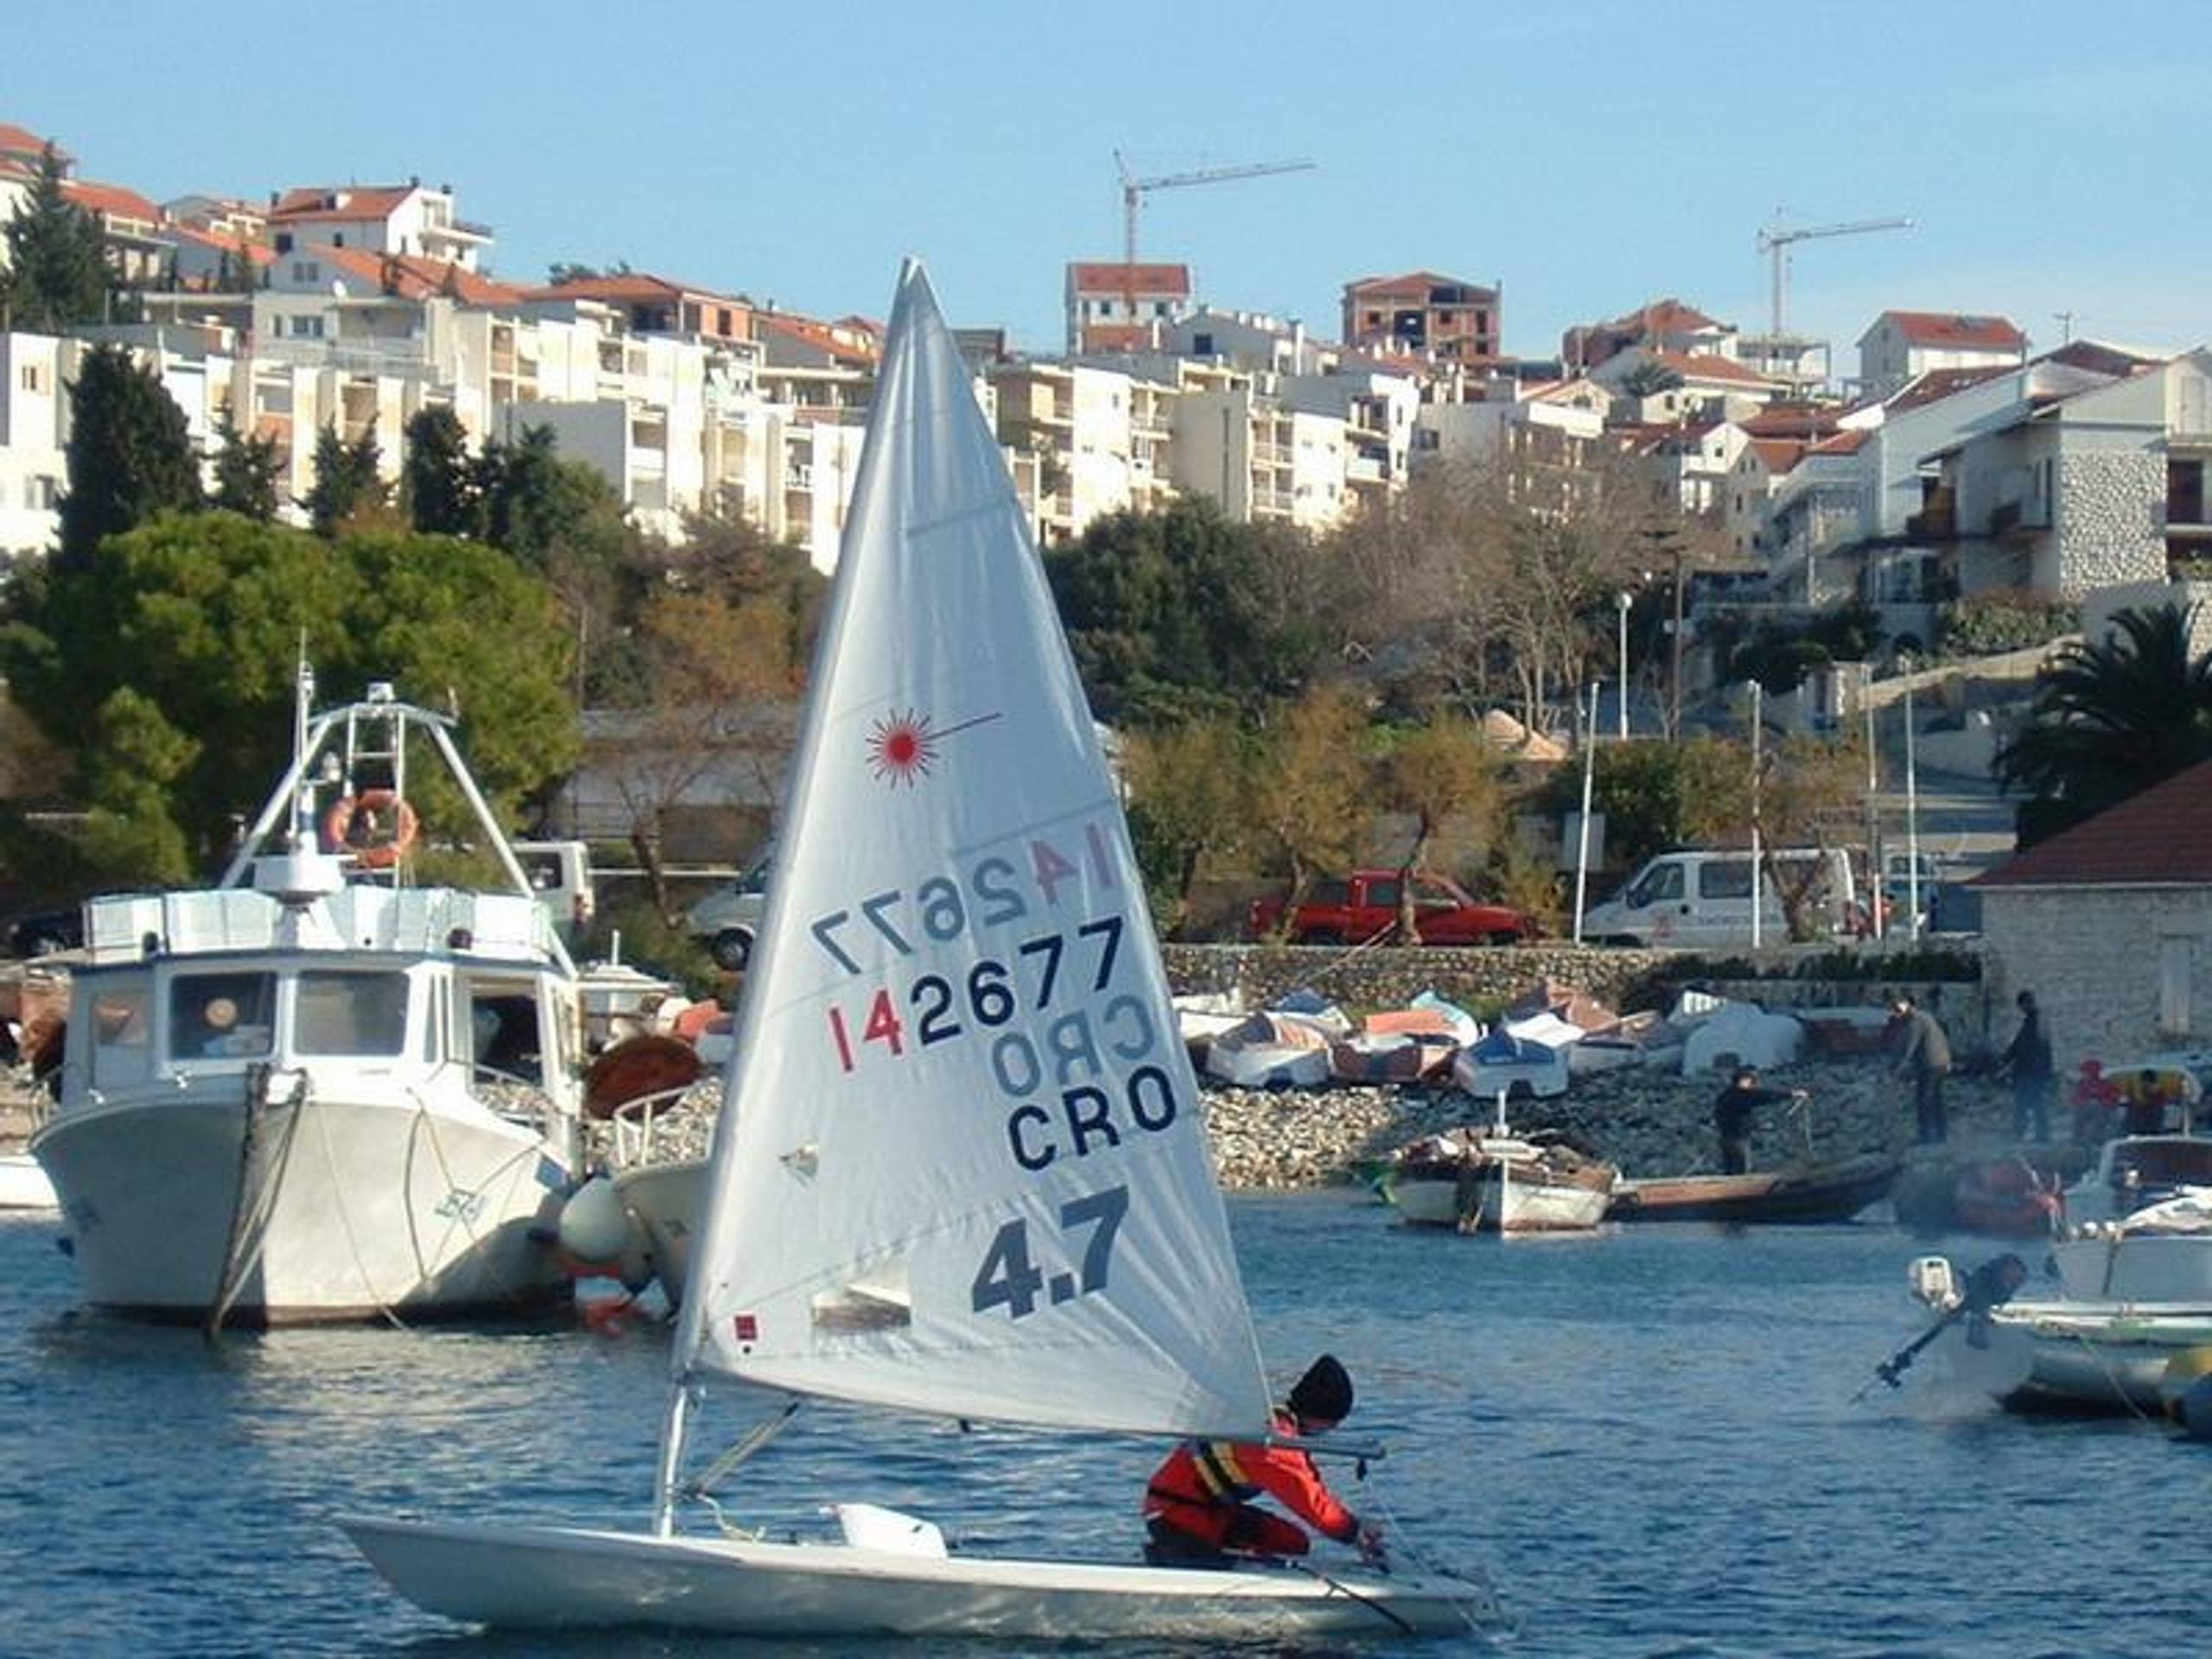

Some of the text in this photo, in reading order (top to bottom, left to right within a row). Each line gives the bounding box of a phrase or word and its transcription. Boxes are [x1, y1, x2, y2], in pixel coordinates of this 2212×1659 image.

[829, 916, 1123, 1071] 142677
[1008, 1065, 1176, 1171] CRO
[972, 1185, 1129, 1320] 4.7
